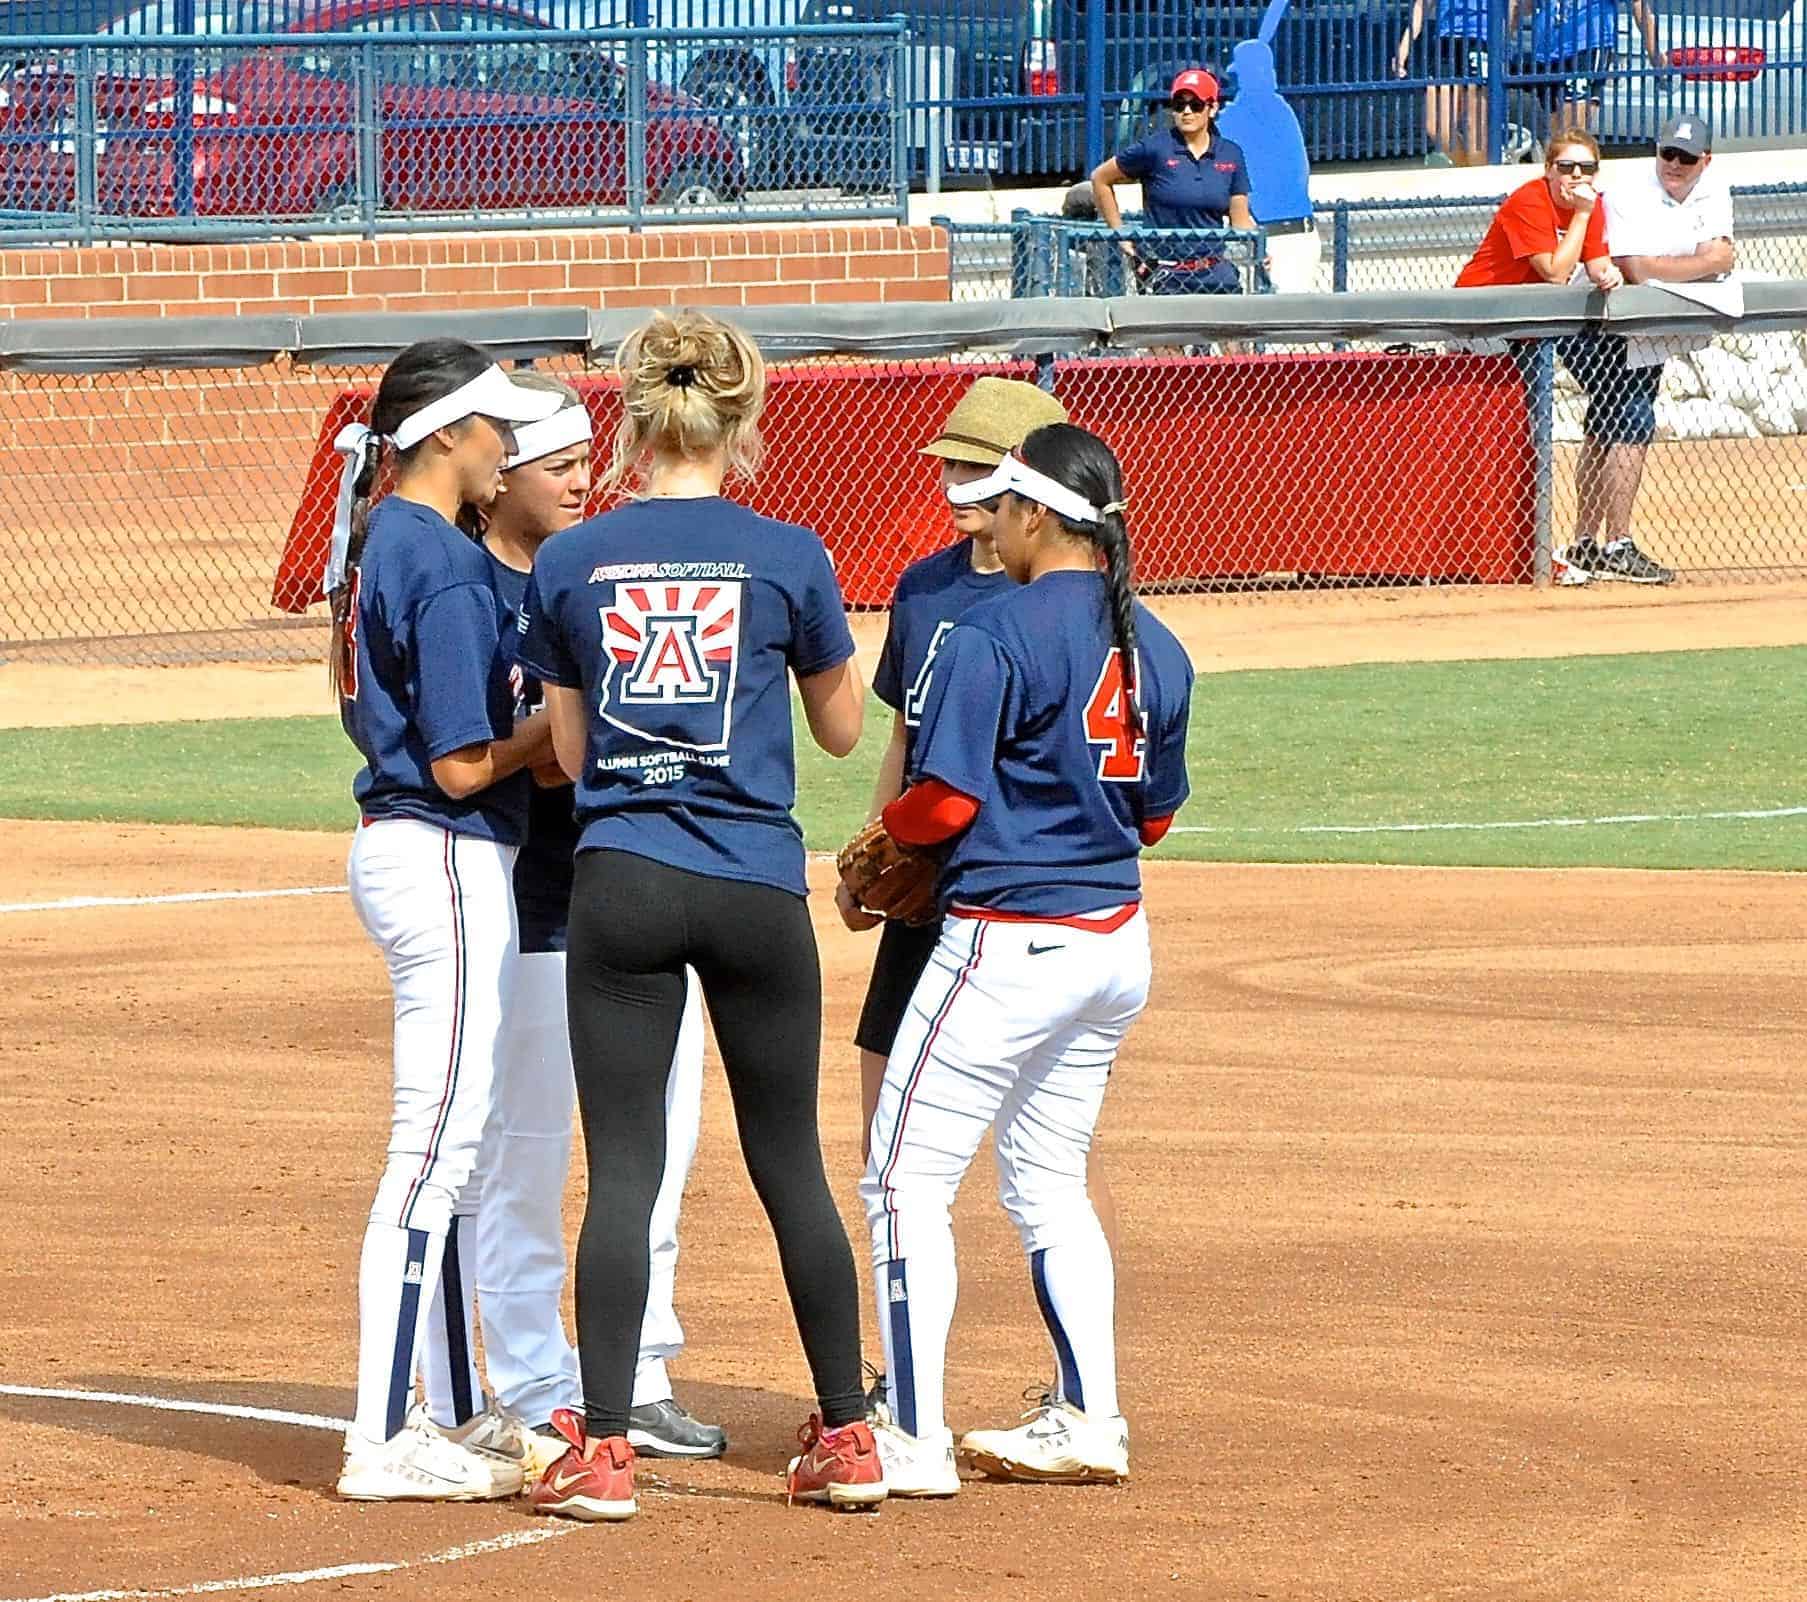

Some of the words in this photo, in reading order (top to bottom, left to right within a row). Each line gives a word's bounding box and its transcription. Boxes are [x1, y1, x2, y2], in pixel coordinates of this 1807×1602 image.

[620, 614, 720, 704] A
[1082, 647, 1148, 782] 4
[597, 756, 638, 770] ALUMNI
[640, 752, 697, 767] SOFTBALL
[698, 755, 731, 768] GAME
[643, 765, 685, 785] 2015
